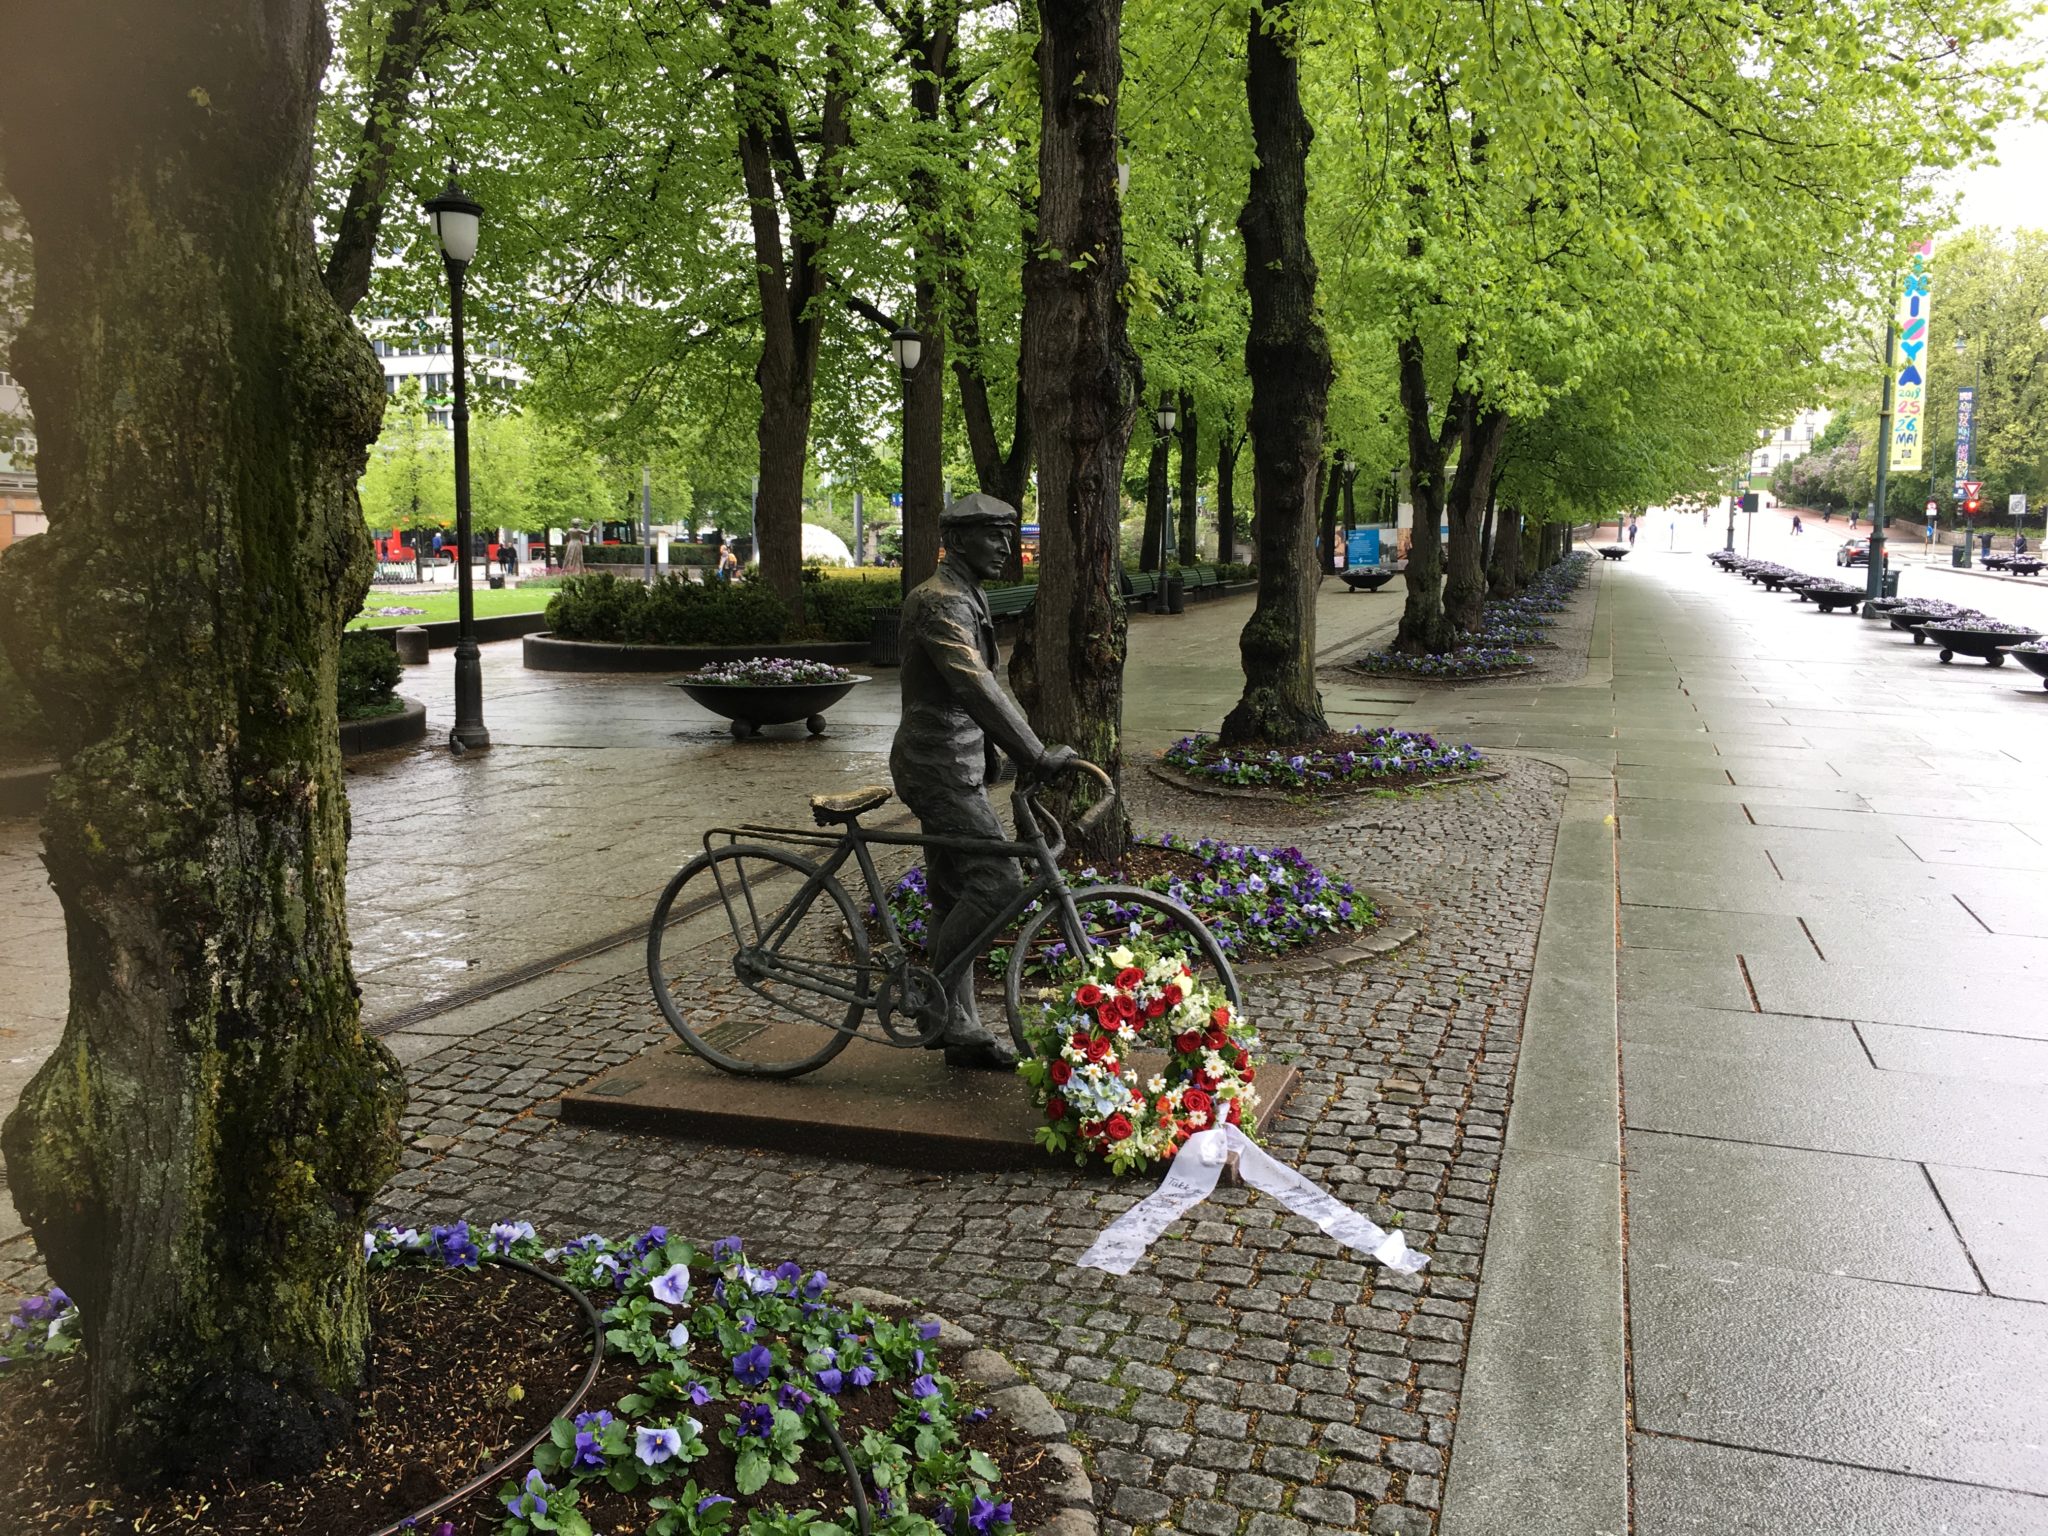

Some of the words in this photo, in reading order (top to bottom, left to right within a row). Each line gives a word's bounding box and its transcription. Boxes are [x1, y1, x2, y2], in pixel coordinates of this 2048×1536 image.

[1898, 401, 1921, 415] 25
[1895, 418, 1917, 432] 26
[1896, 432, 1917, 447] MAI
